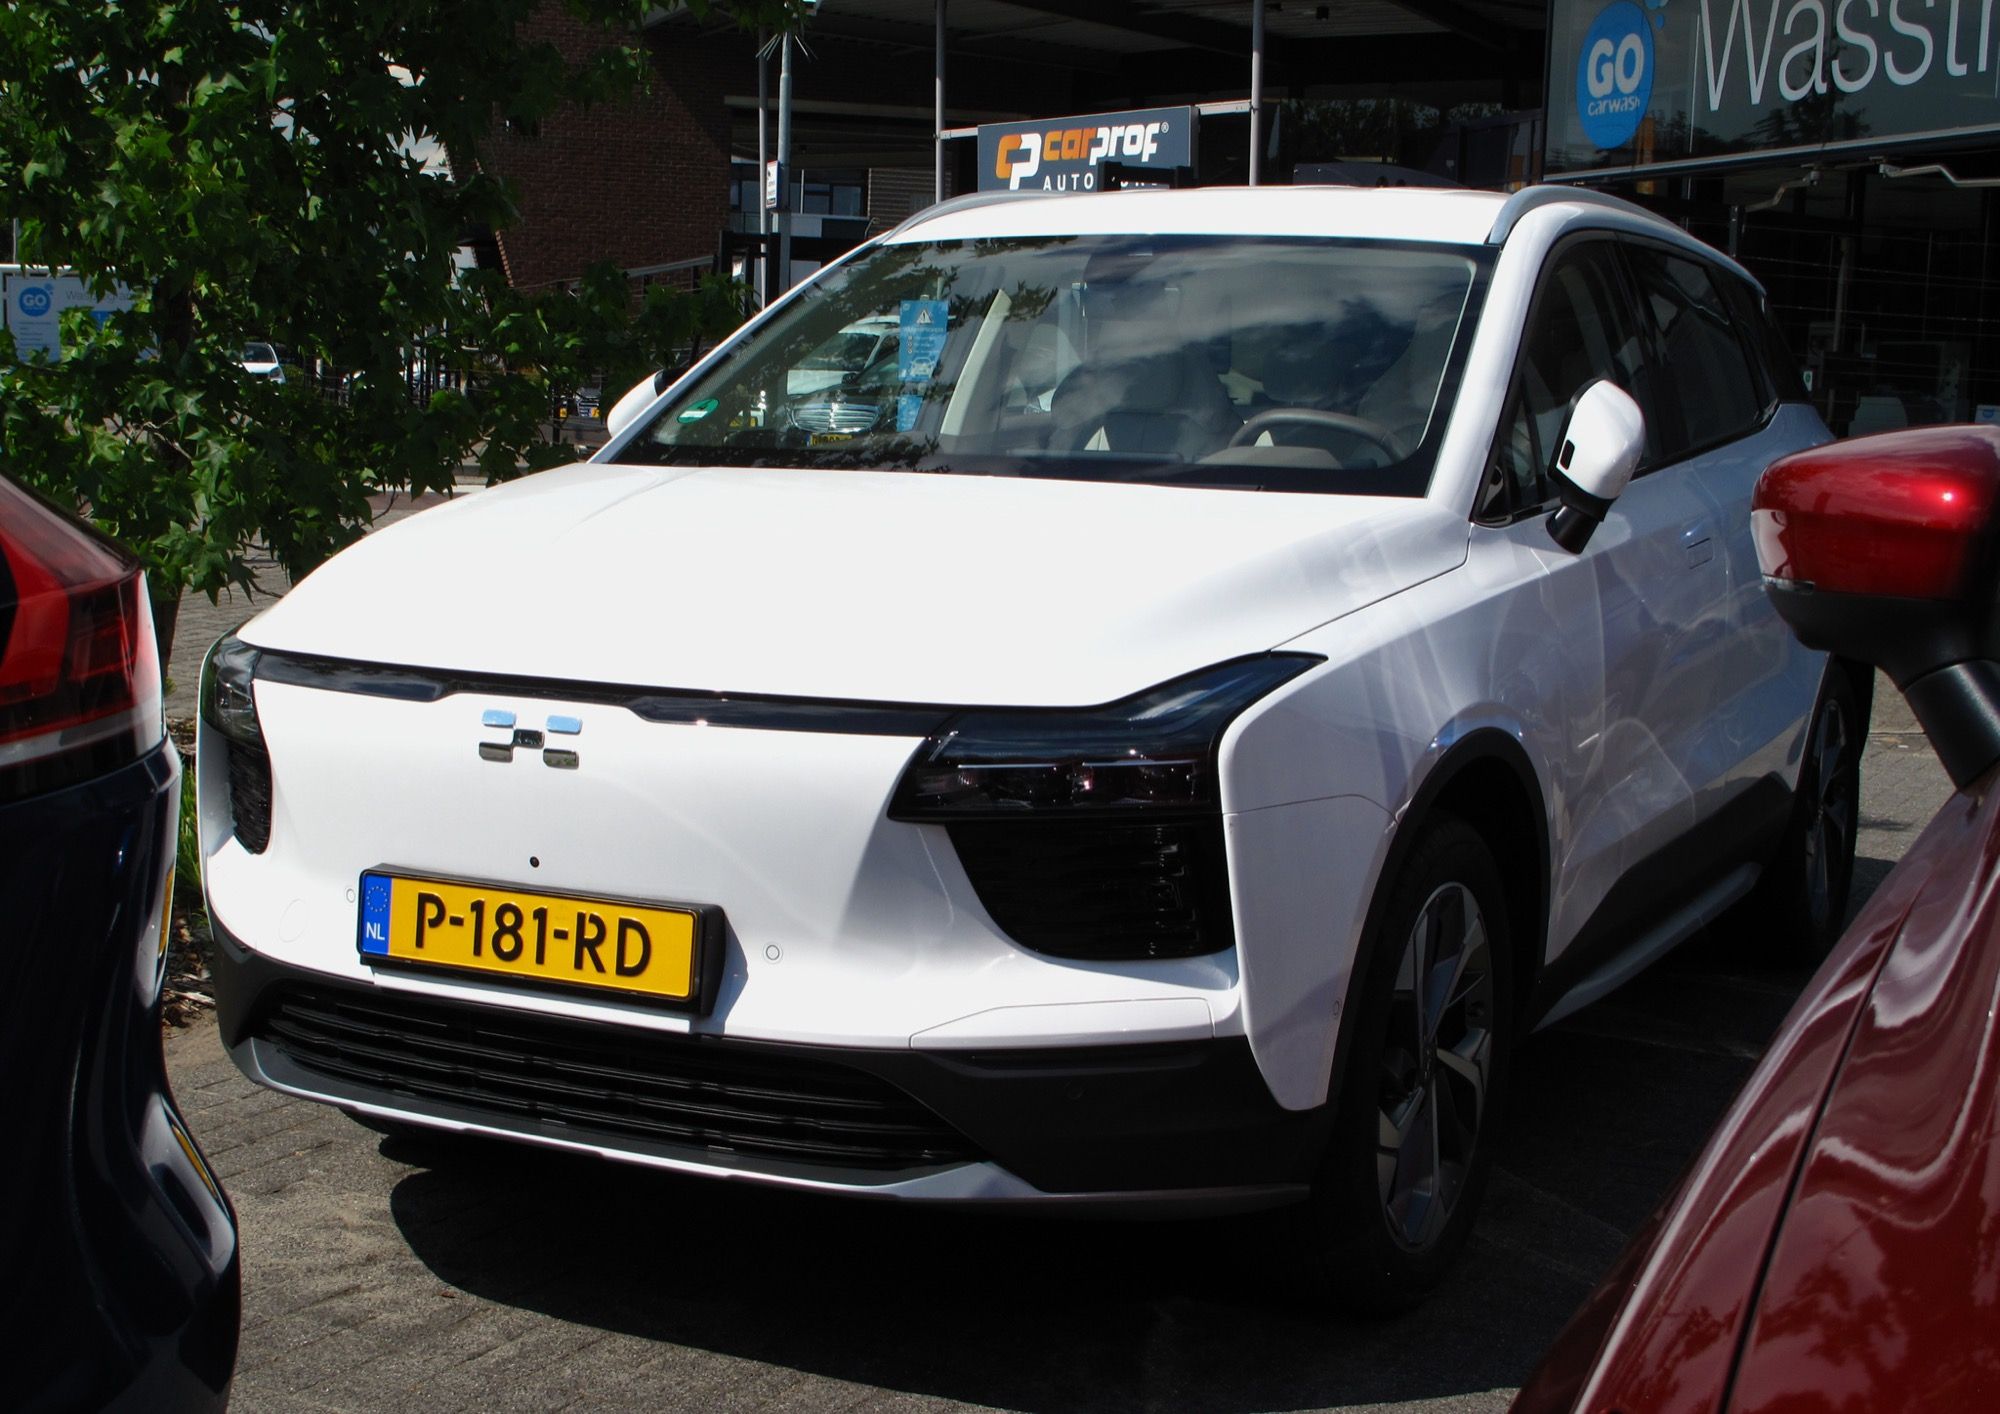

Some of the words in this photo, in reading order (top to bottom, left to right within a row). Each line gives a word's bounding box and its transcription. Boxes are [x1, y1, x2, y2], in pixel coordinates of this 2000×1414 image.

[1587, 33, 1644, 98] GO
[1043, 173, 1094, 191] AUTO
[22, 293, 47, 307] GO
[365, 920, 386, 941] NL
[415, 891, 652, 978] P-181-RD
